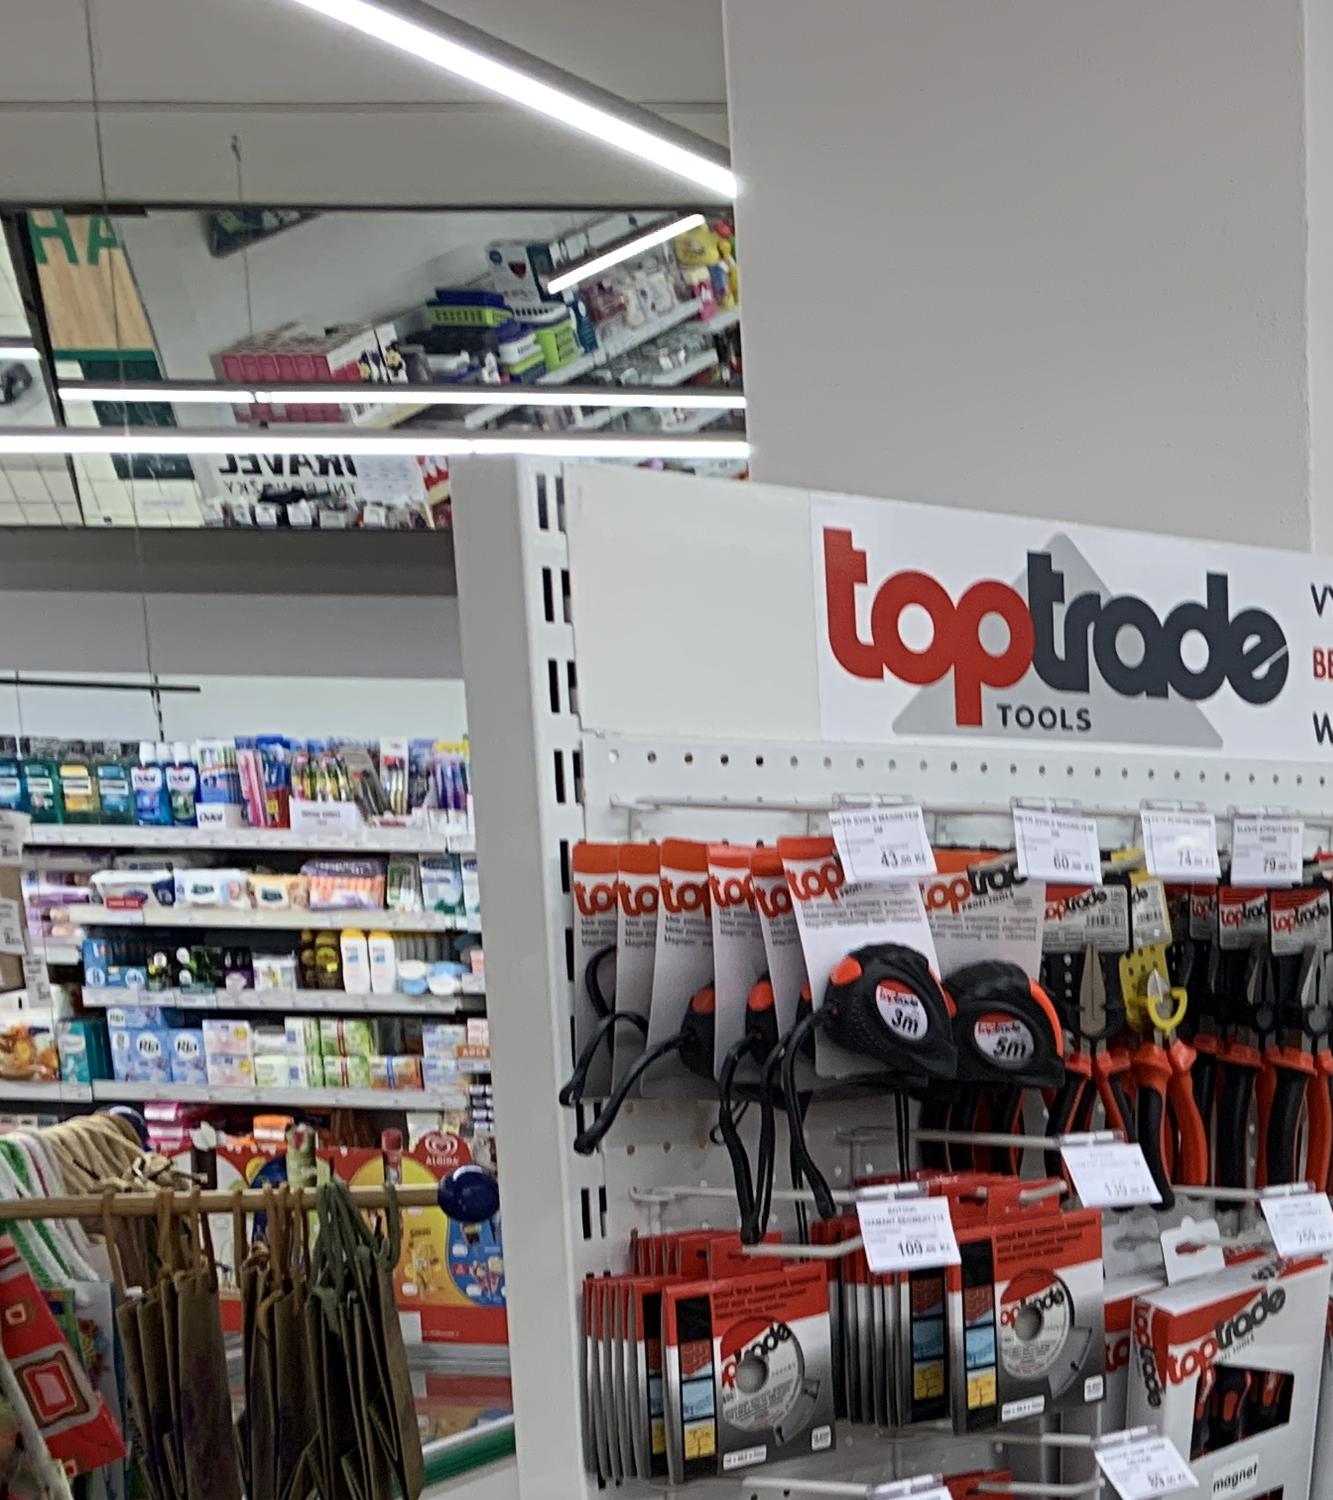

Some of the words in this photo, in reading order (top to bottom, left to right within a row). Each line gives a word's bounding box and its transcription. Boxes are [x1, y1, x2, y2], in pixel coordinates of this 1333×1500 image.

[823, 525, 1289, 726] toptrade
[998, 703, 1092, 732] TOOLS
[1213, 1462, 1258, 1493] magnet
